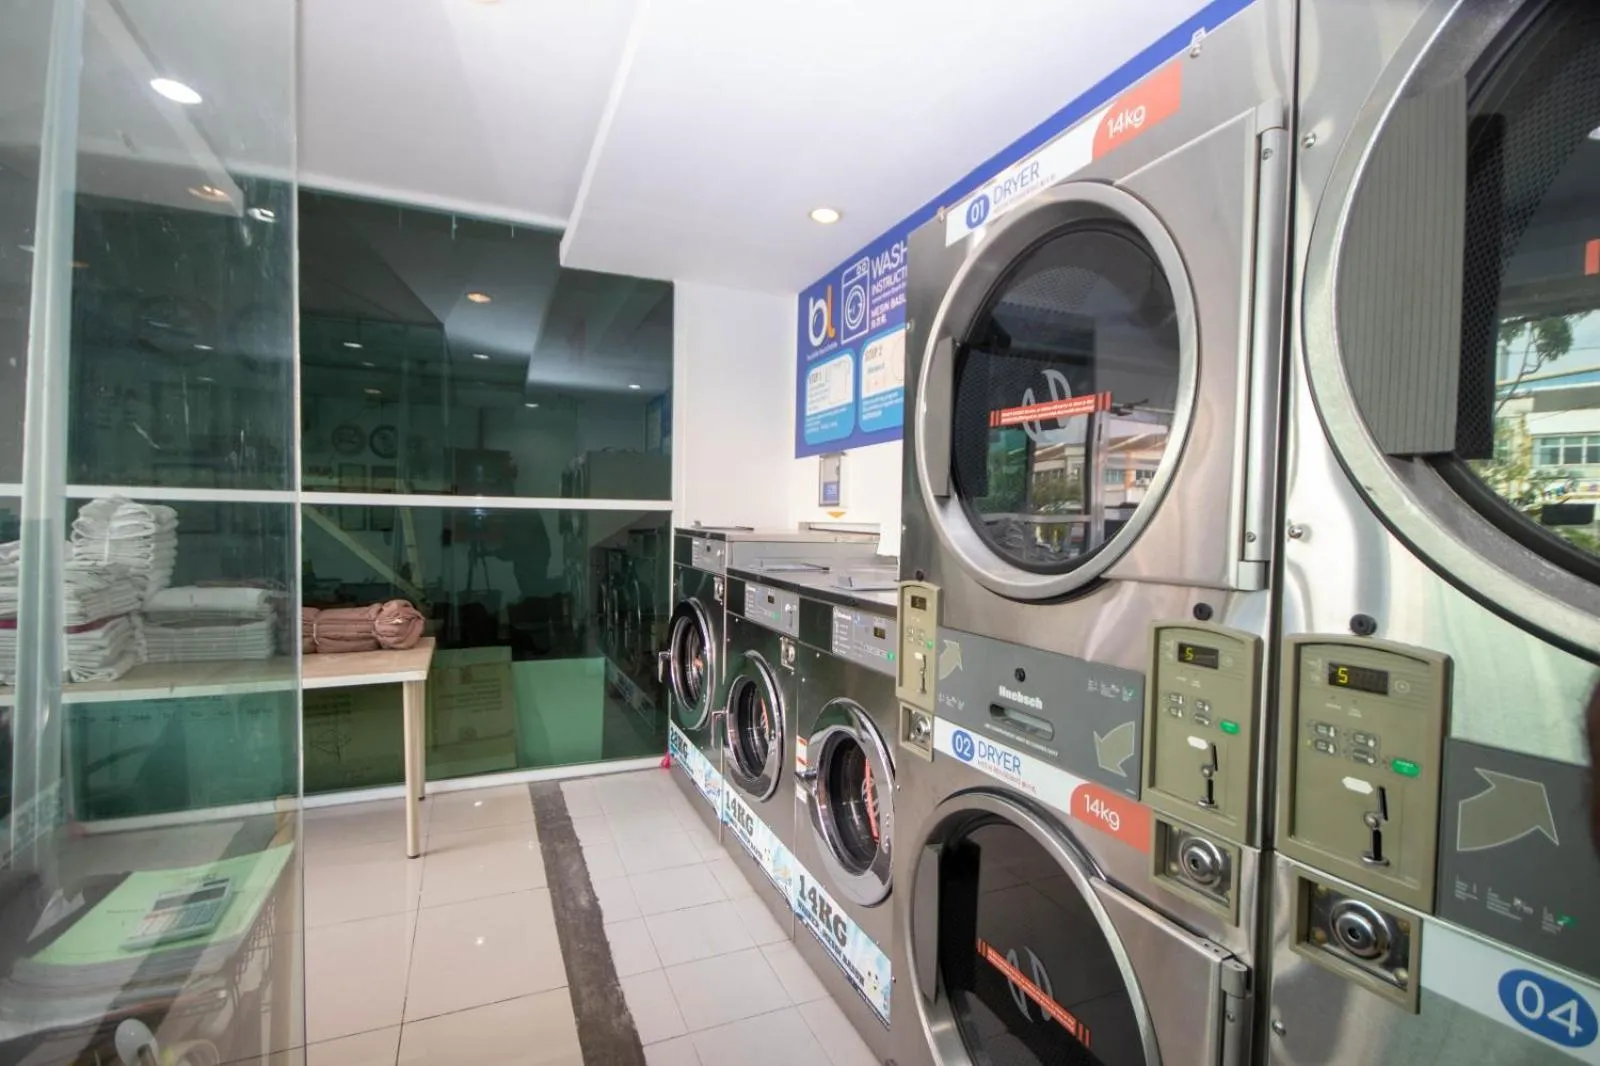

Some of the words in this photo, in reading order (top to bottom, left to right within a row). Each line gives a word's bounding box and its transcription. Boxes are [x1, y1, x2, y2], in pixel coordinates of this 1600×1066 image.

[1106, 105, 1146, 139] 14kg
[971, 199, 985, 223] 01
[993, 160, 1040, 204] DRYER
[955, 736, 972, 757] 02
[977, 740, 1022, 775] DRYER
[726, 790, 753, 837] 14KG
[1084, 794, 1120, 831] 14kg
[799, 874, 847, 948] 14KG
[1515, 979, 1583, 1039] 04
